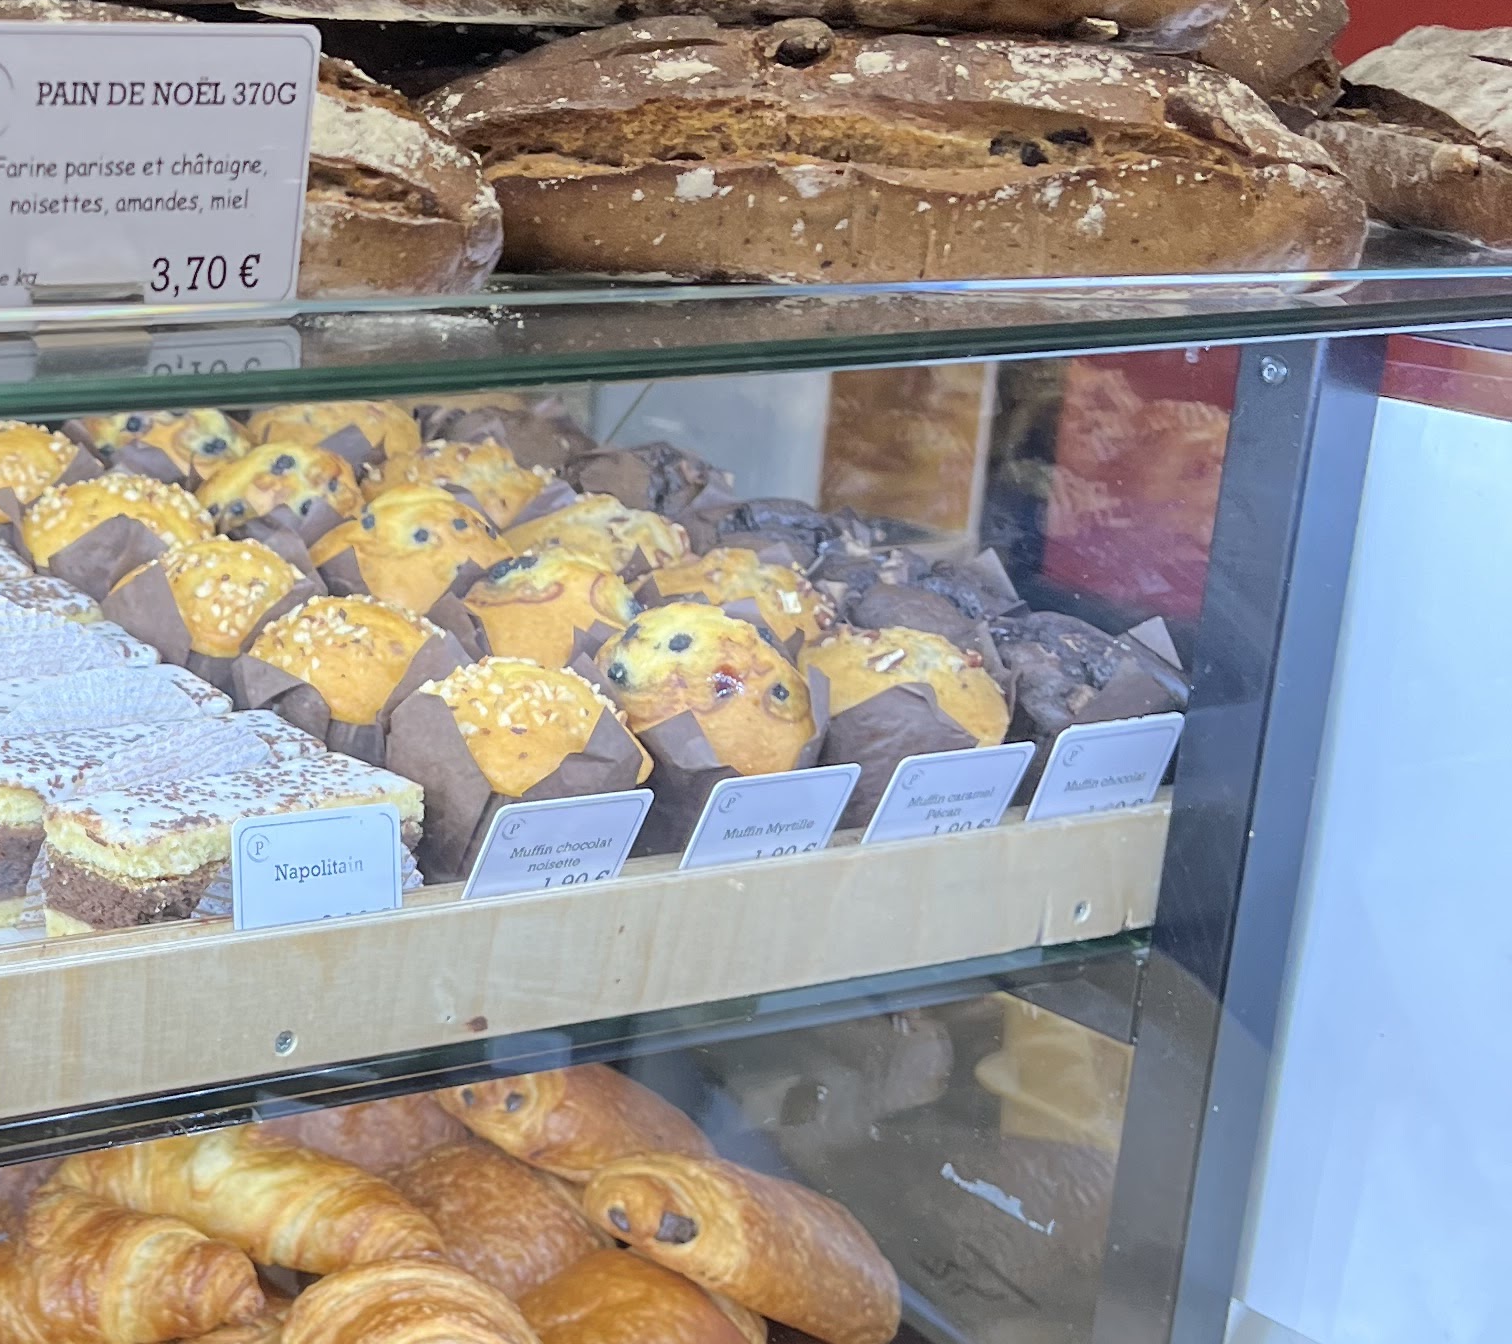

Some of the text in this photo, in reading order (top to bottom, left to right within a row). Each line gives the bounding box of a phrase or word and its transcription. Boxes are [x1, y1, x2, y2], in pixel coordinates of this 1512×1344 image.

[36, 77, 297, 106] PAIN DE NOËL 370G
[66, 157, 135, 183] parisse
[143, 158, 164, 176] et
[171, 154, 267, 181] châtaigne,
[10, 189, 248, 215] noisettes, amandes, miel
[150, 253, 260, 298] 3,70 €
[723, 819, 814, 840] Muffin Myrtille
[256, 842, 264, 855] P
[509, 838, 613, 859] Muffin chocolat
[275, 856, 363, 883] Napolitain
[527, 858, 581, 872] noisette
